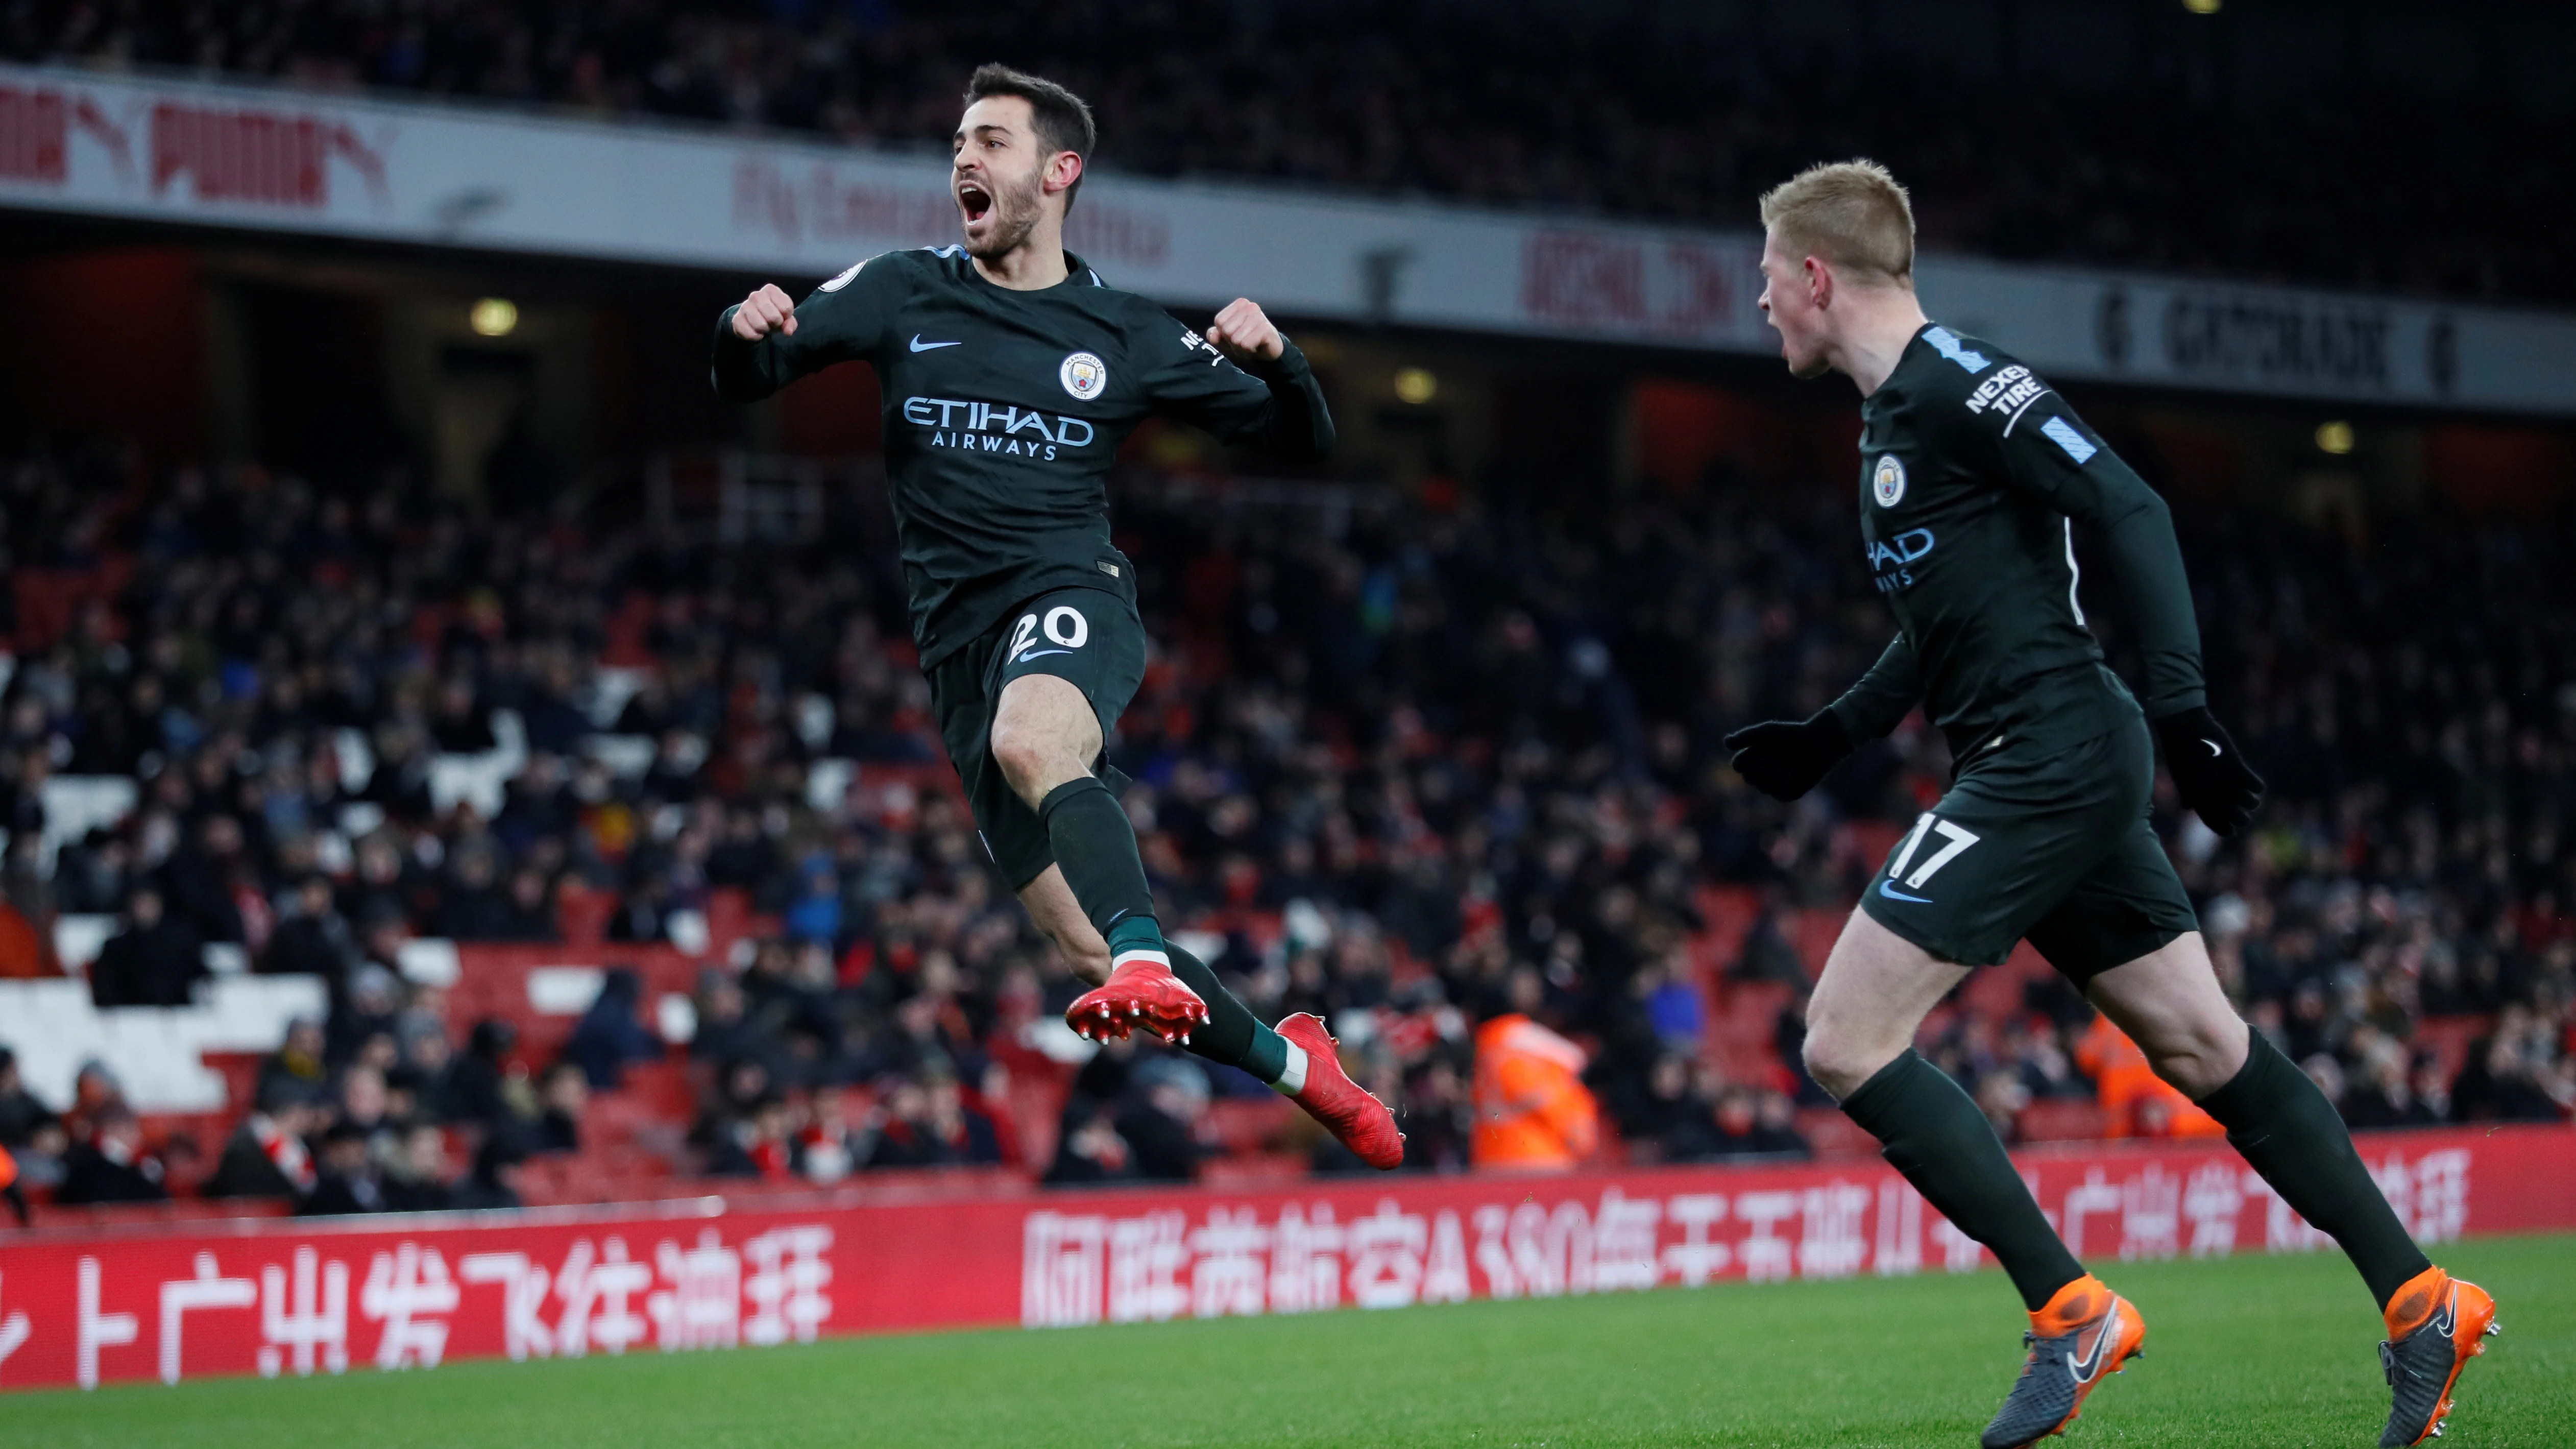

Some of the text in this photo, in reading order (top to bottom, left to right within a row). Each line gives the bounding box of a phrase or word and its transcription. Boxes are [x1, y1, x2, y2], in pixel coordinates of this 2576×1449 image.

[1066, 355, 1104, 375] MANCHESTER
[1991, 376, 2042, 415] TIRE
[904, 396, 1093, 447] ETIHAD
[932, 431, 1056, 461] AIRWAYS
[1007, 606, 1088, 665] 20
[1889, 813, 1980, 889] 17
